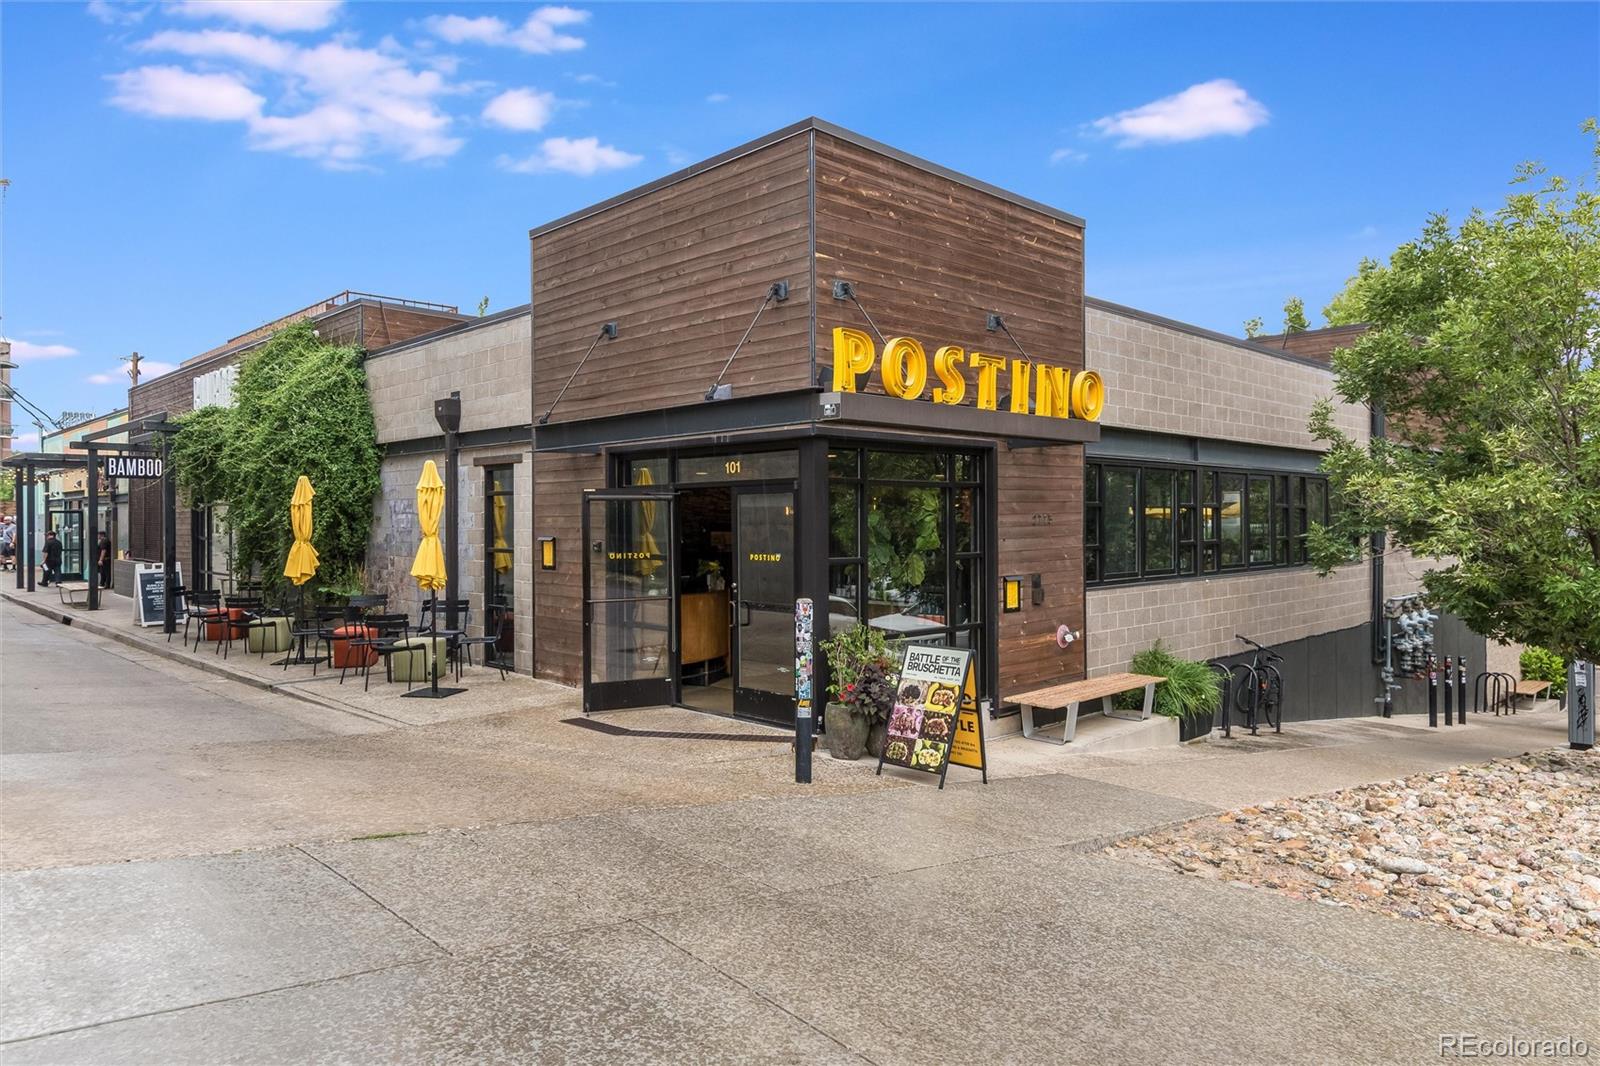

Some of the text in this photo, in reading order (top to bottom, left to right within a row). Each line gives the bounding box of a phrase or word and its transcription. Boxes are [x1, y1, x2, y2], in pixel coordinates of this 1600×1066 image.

[832, 326, 1105, 422] POSTINO
[108, 457, 162, 477] BAMBOO
[725, 461, 740, 474] 101
[749, 553, 782, 562] POSTINO
[909, 652, 941, 665] BATTLE
[907, 661, 961, 677] BRUSCHETTA
